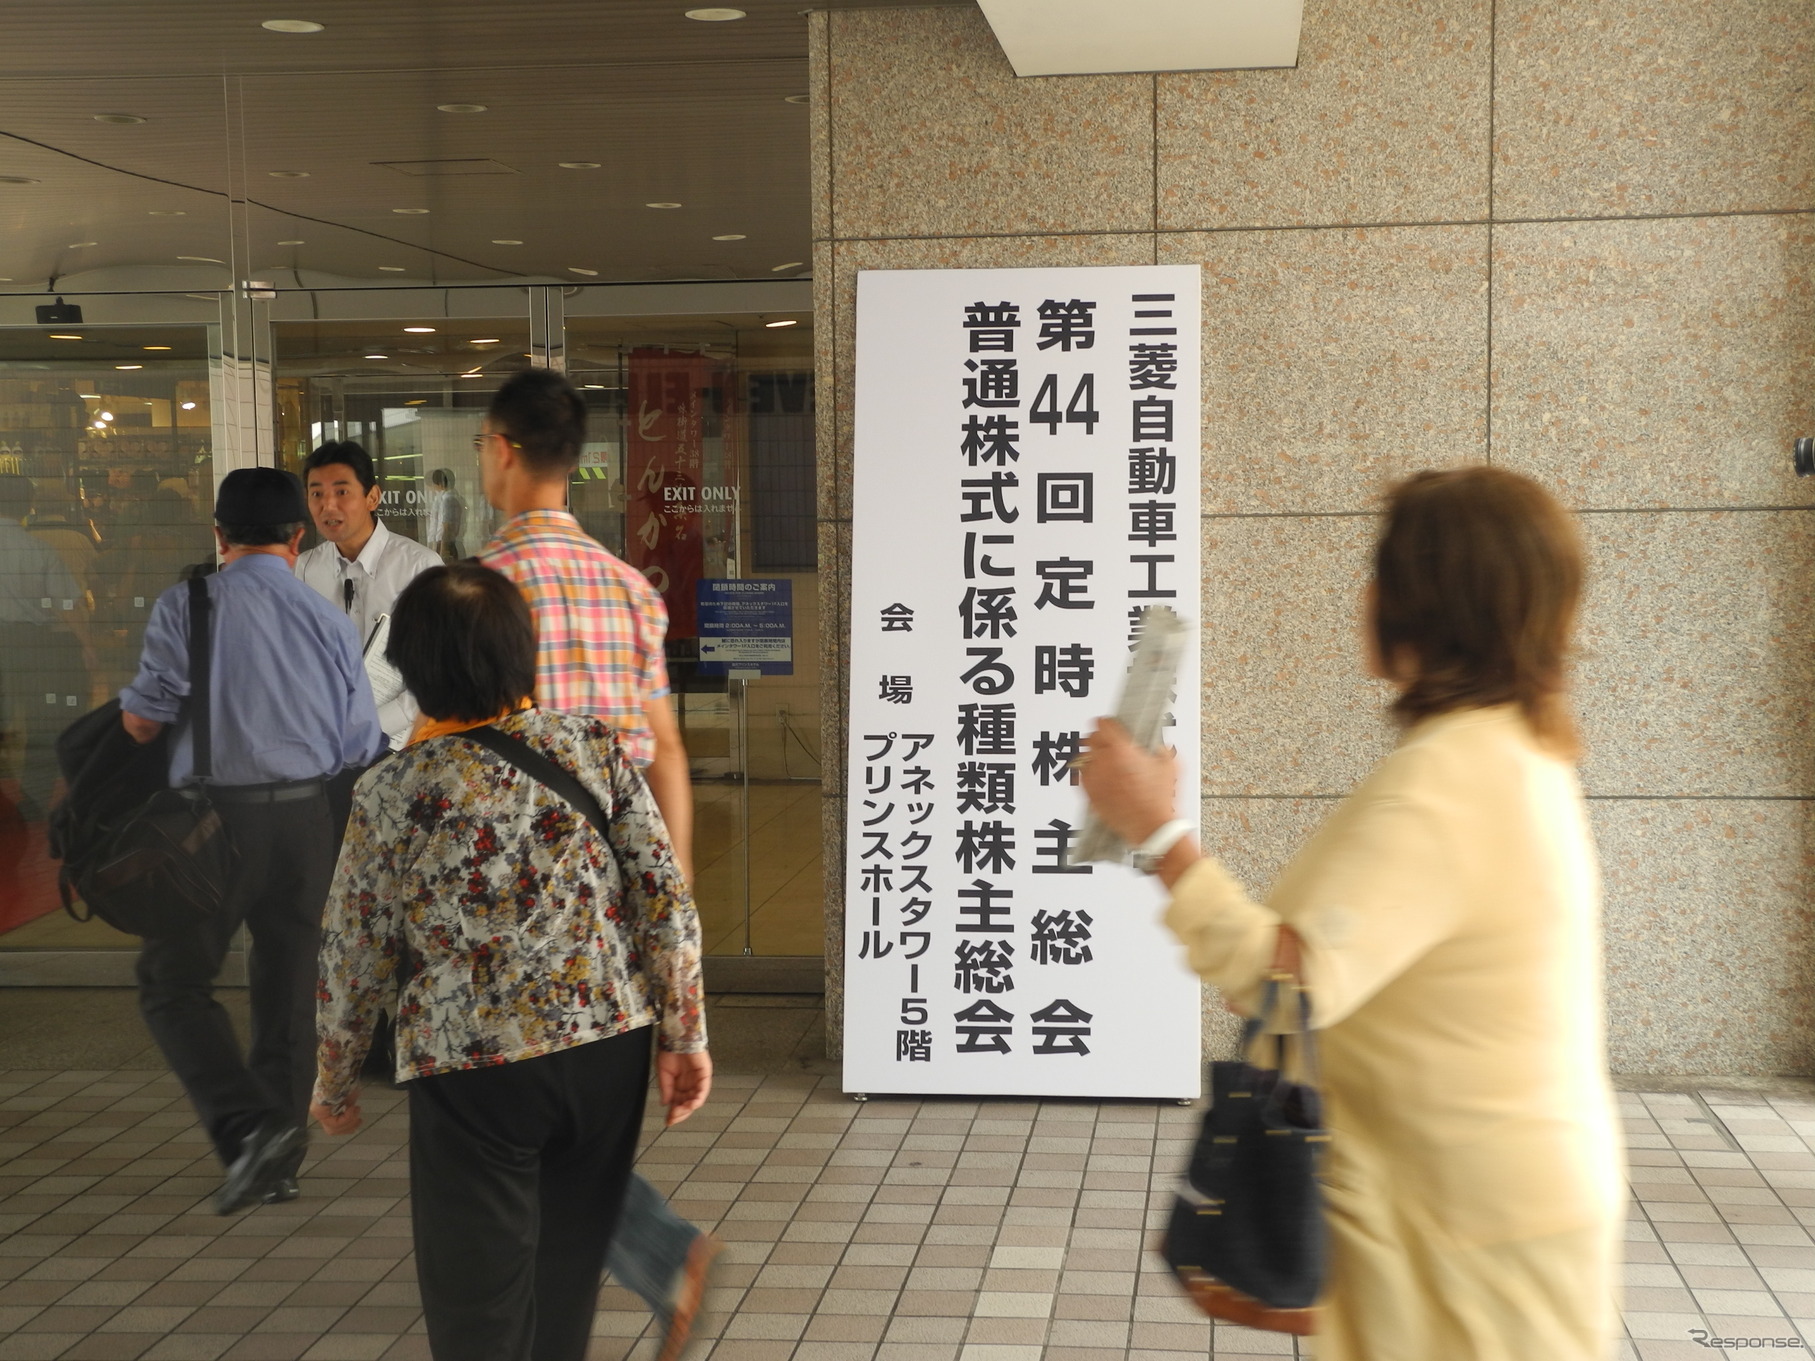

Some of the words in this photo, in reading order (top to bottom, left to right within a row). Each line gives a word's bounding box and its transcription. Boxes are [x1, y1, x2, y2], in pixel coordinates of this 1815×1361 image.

[379, 490, 400, 505] XIT
[664, 486, 696, 501] EXIT
[701, 486, 741, 501] ONLY
[664, 504, 739, 514] ここからは入れませ
[879, 603, 914, 704] 会場
[954, 301, 1020, 1054] 普通株式に係る種類株主総会
[1030, 299, 1099, 1056] 第44回定時株主総会
[859, 732, 896, 959] プリンスホール
[897, 734, 935, 1061] アネックスタワー5階
